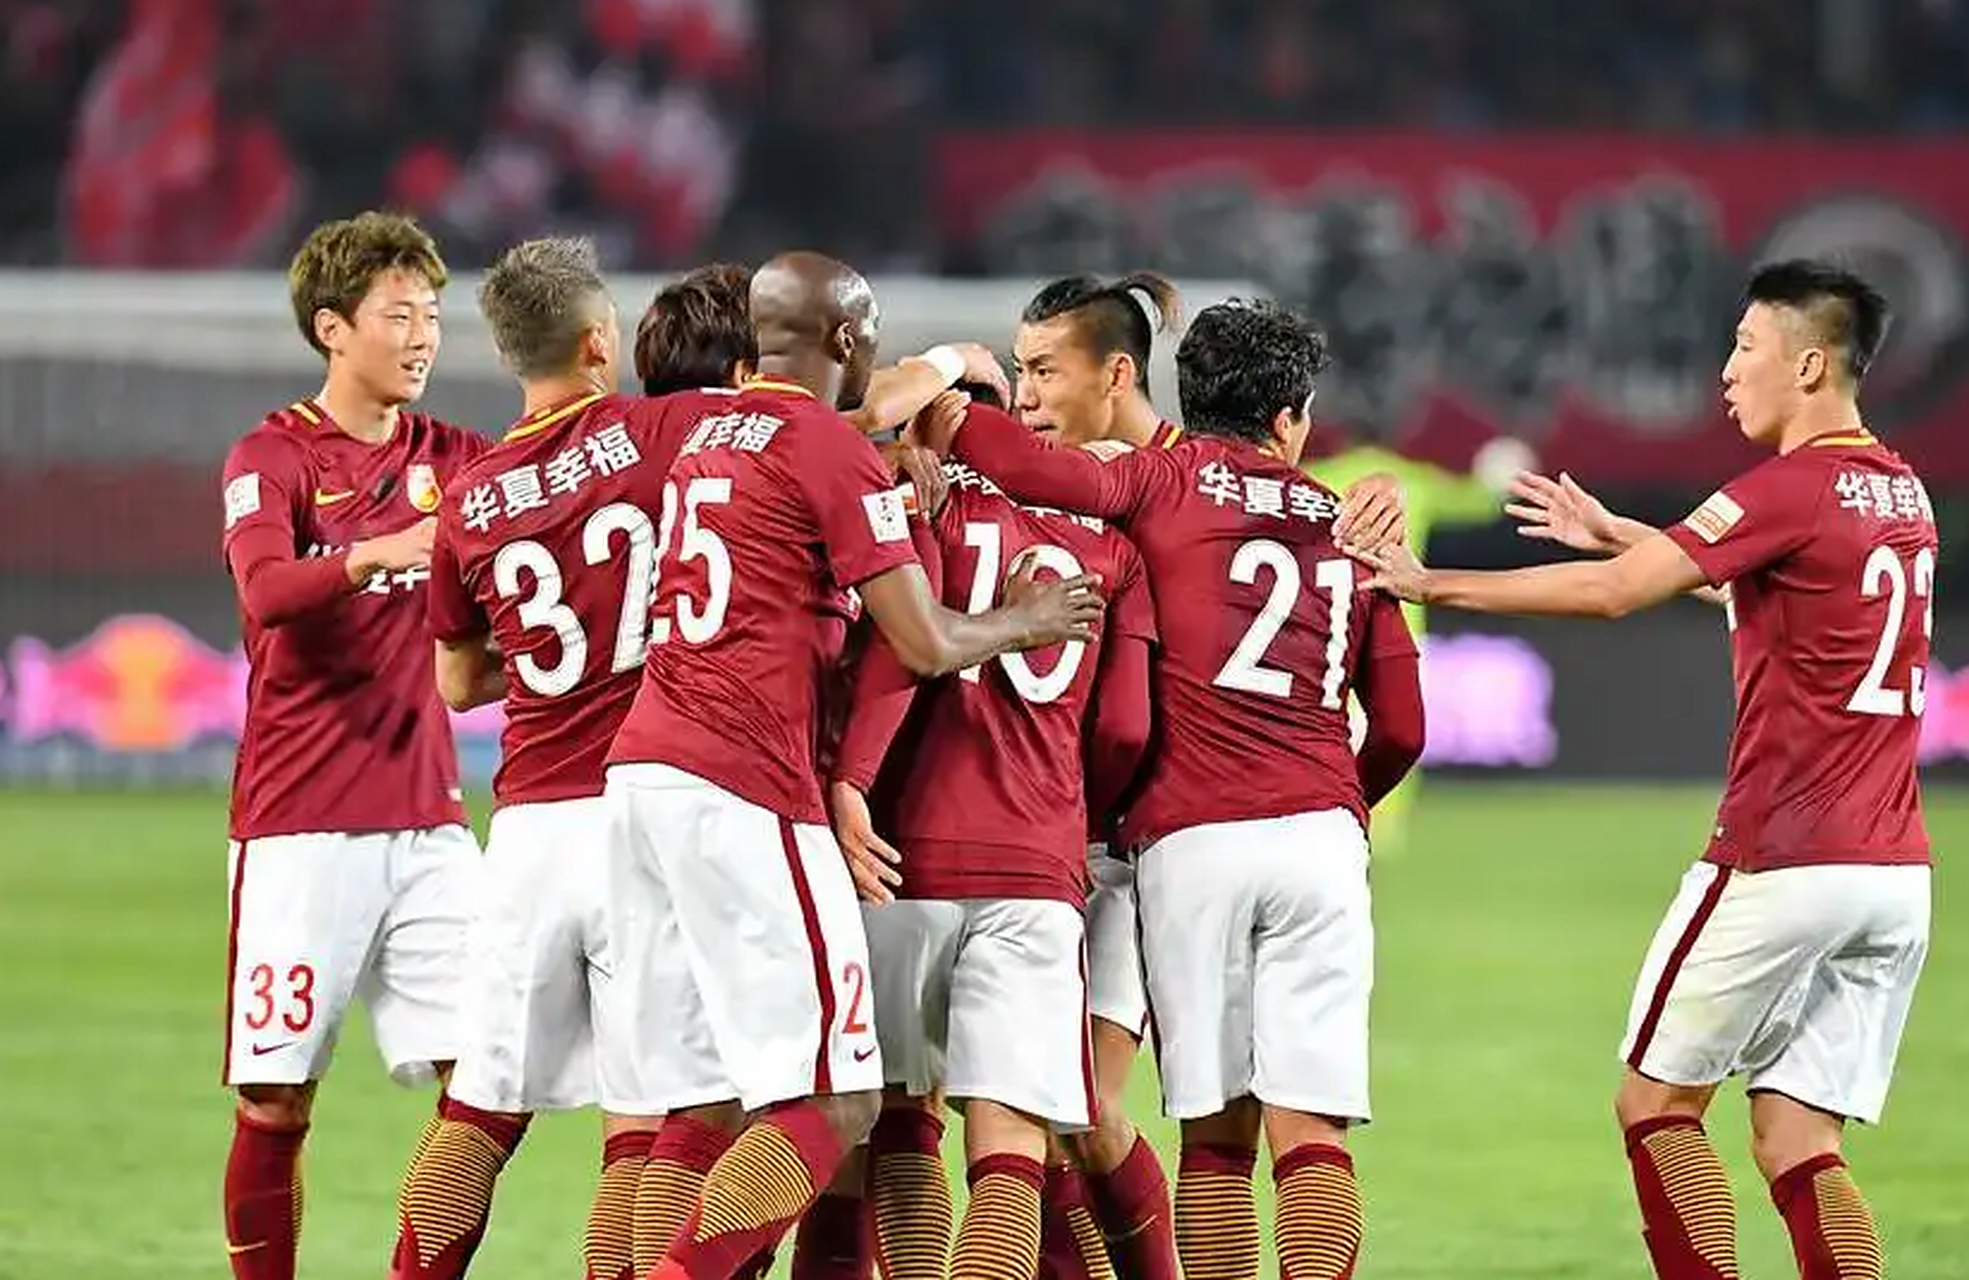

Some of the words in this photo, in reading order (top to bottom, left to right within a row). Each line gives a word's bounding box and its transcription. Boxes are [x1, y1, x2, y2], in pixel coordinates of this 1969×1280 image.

[460, 422, 641, 532] 华夏幸福
[494, 502, 656, 696] 32
[1212, 538, 1354, 710] 21
[245, 963, 314, 1033] 33
[841, 962, 867, 1034] 2
